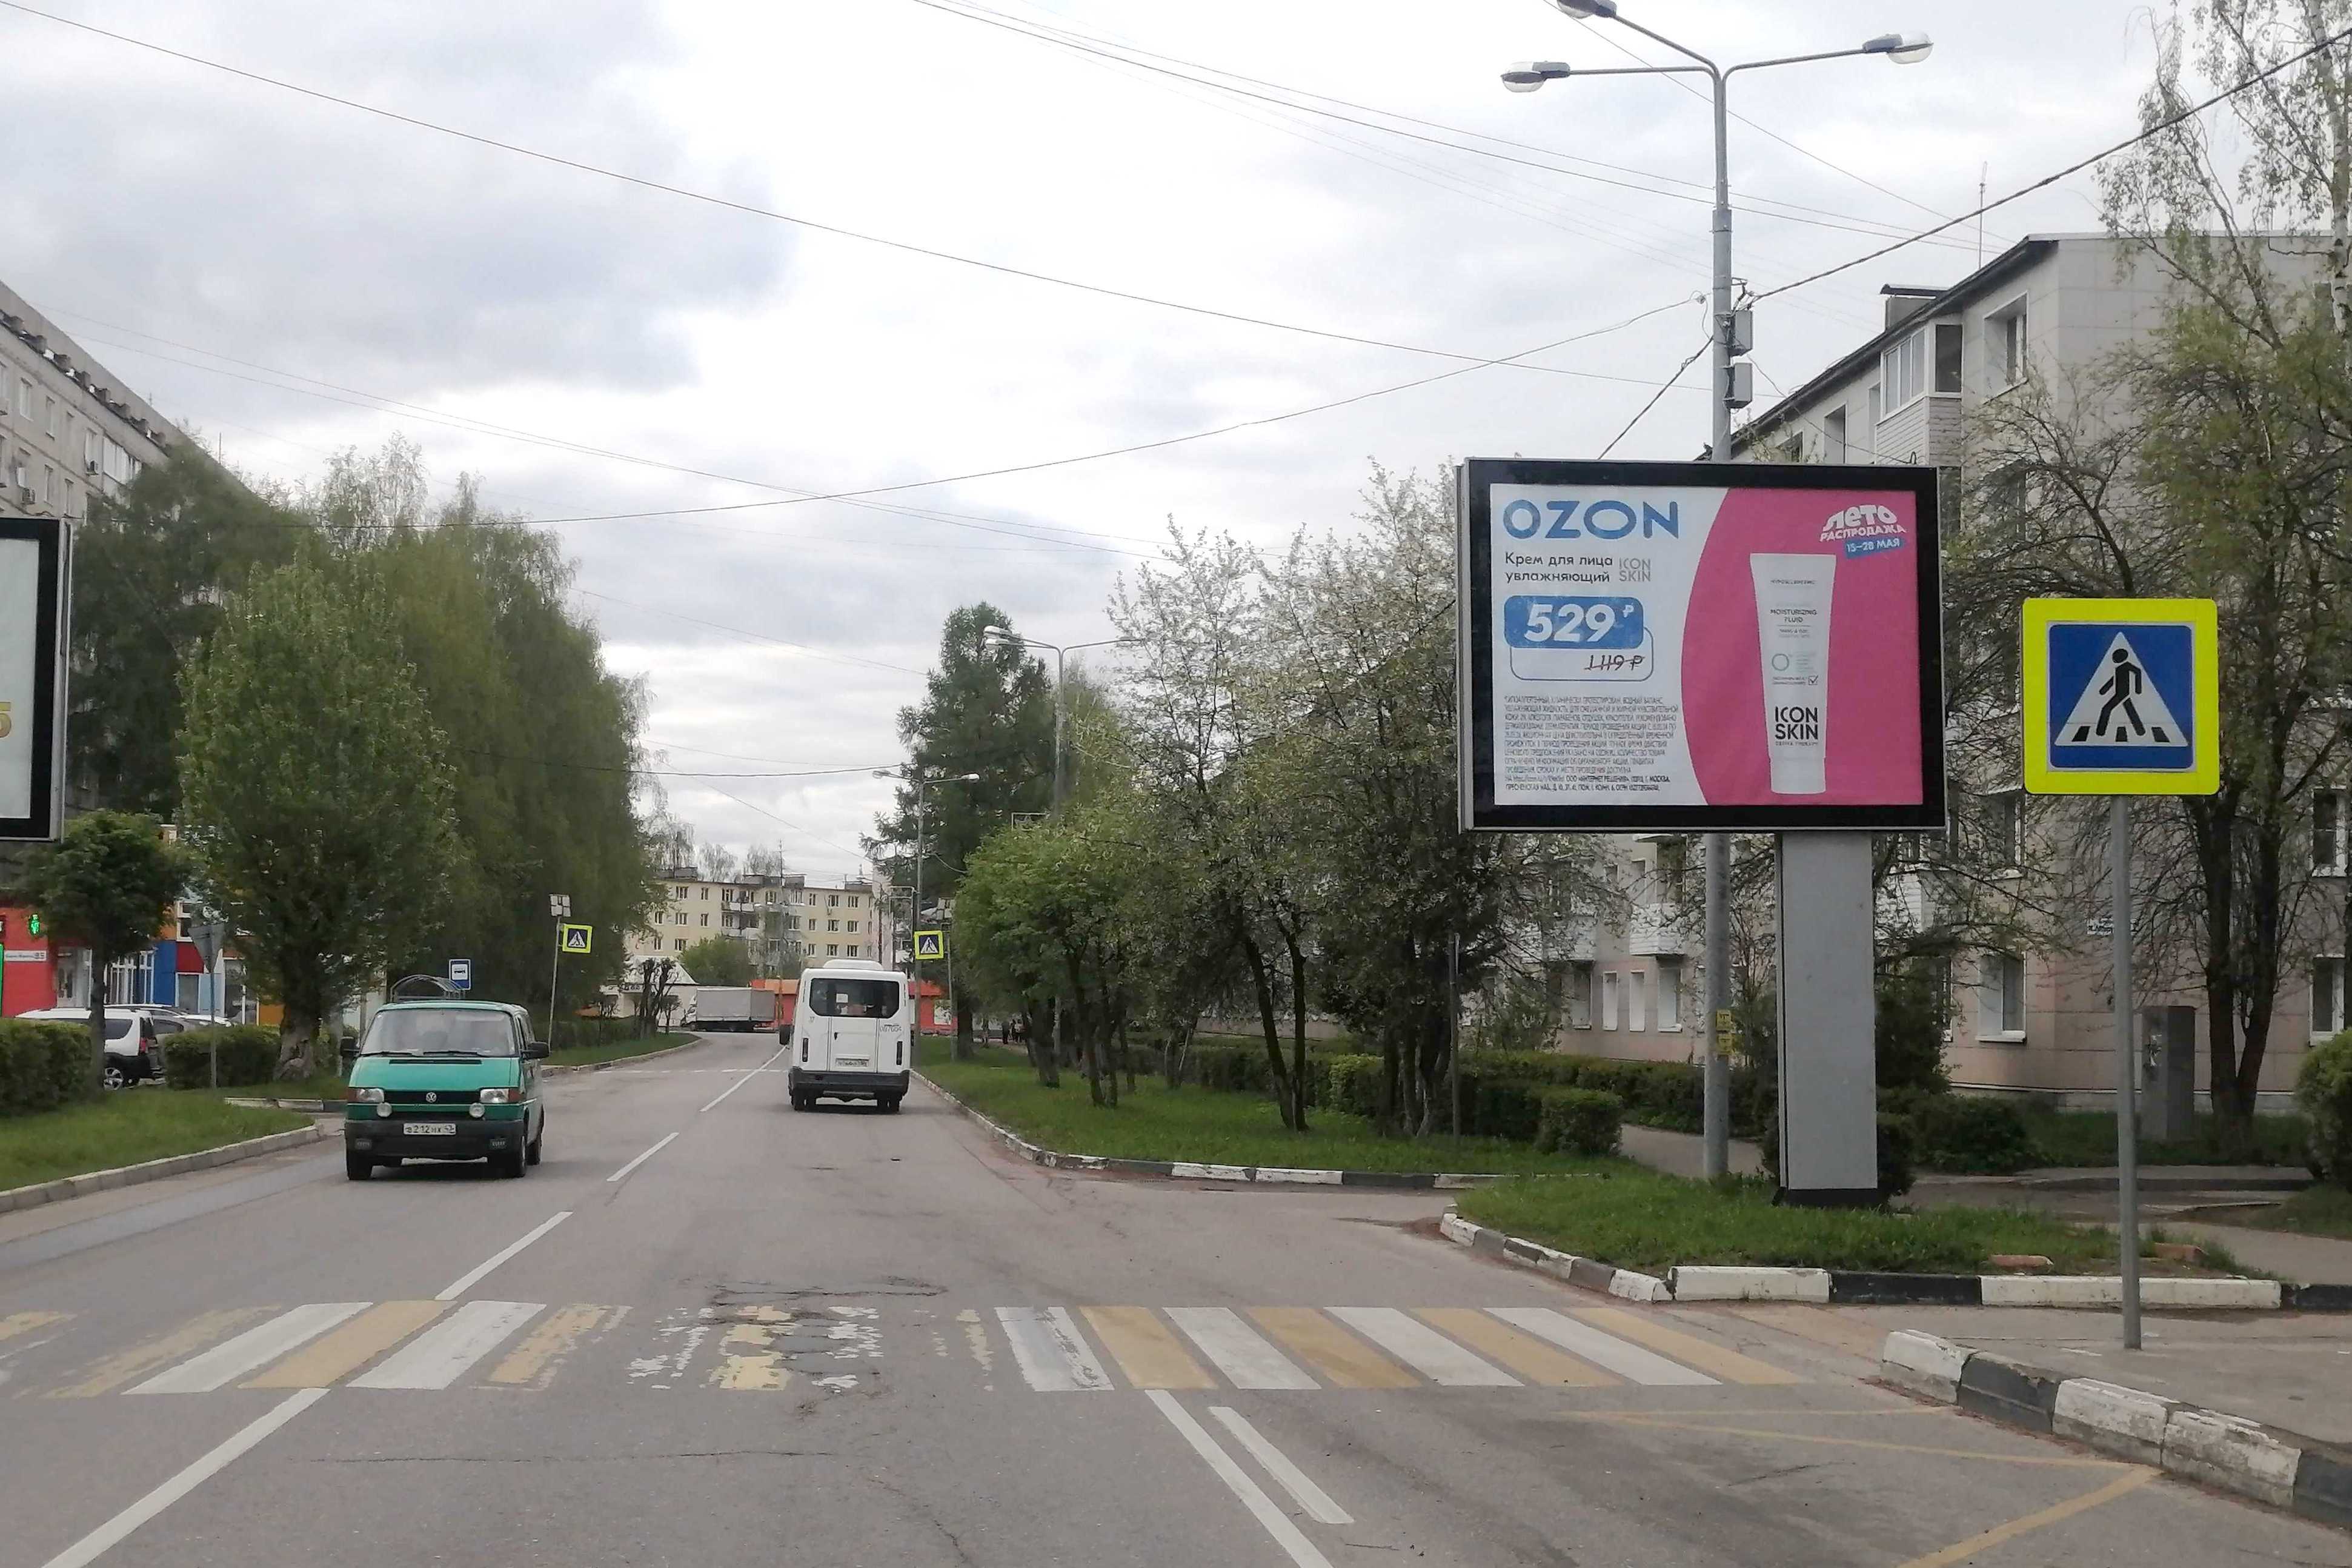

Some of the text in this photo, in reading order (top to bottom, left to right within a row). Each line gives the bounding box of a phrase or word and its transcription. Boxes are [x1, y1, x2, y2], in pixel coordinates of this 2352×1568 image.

[1503, 500, 1678, 539] OZON
[1819, 525, 1907, 542] РАСПРОДАЖА
[1877, 538, 1900, 548] МАЯ
[1505, 551, 1613, 567] Крем для лица
[1619, 557, 1651, 570] ICON
[1506, 571, 1610, 584] увлажняющий
[1619, 571, 1651, 582] SKIN
[1524, 603, 1616, 642] 529
[1775, 706, 1818, 723] ICON
[1775, 723, 1818, 740] SKIN
